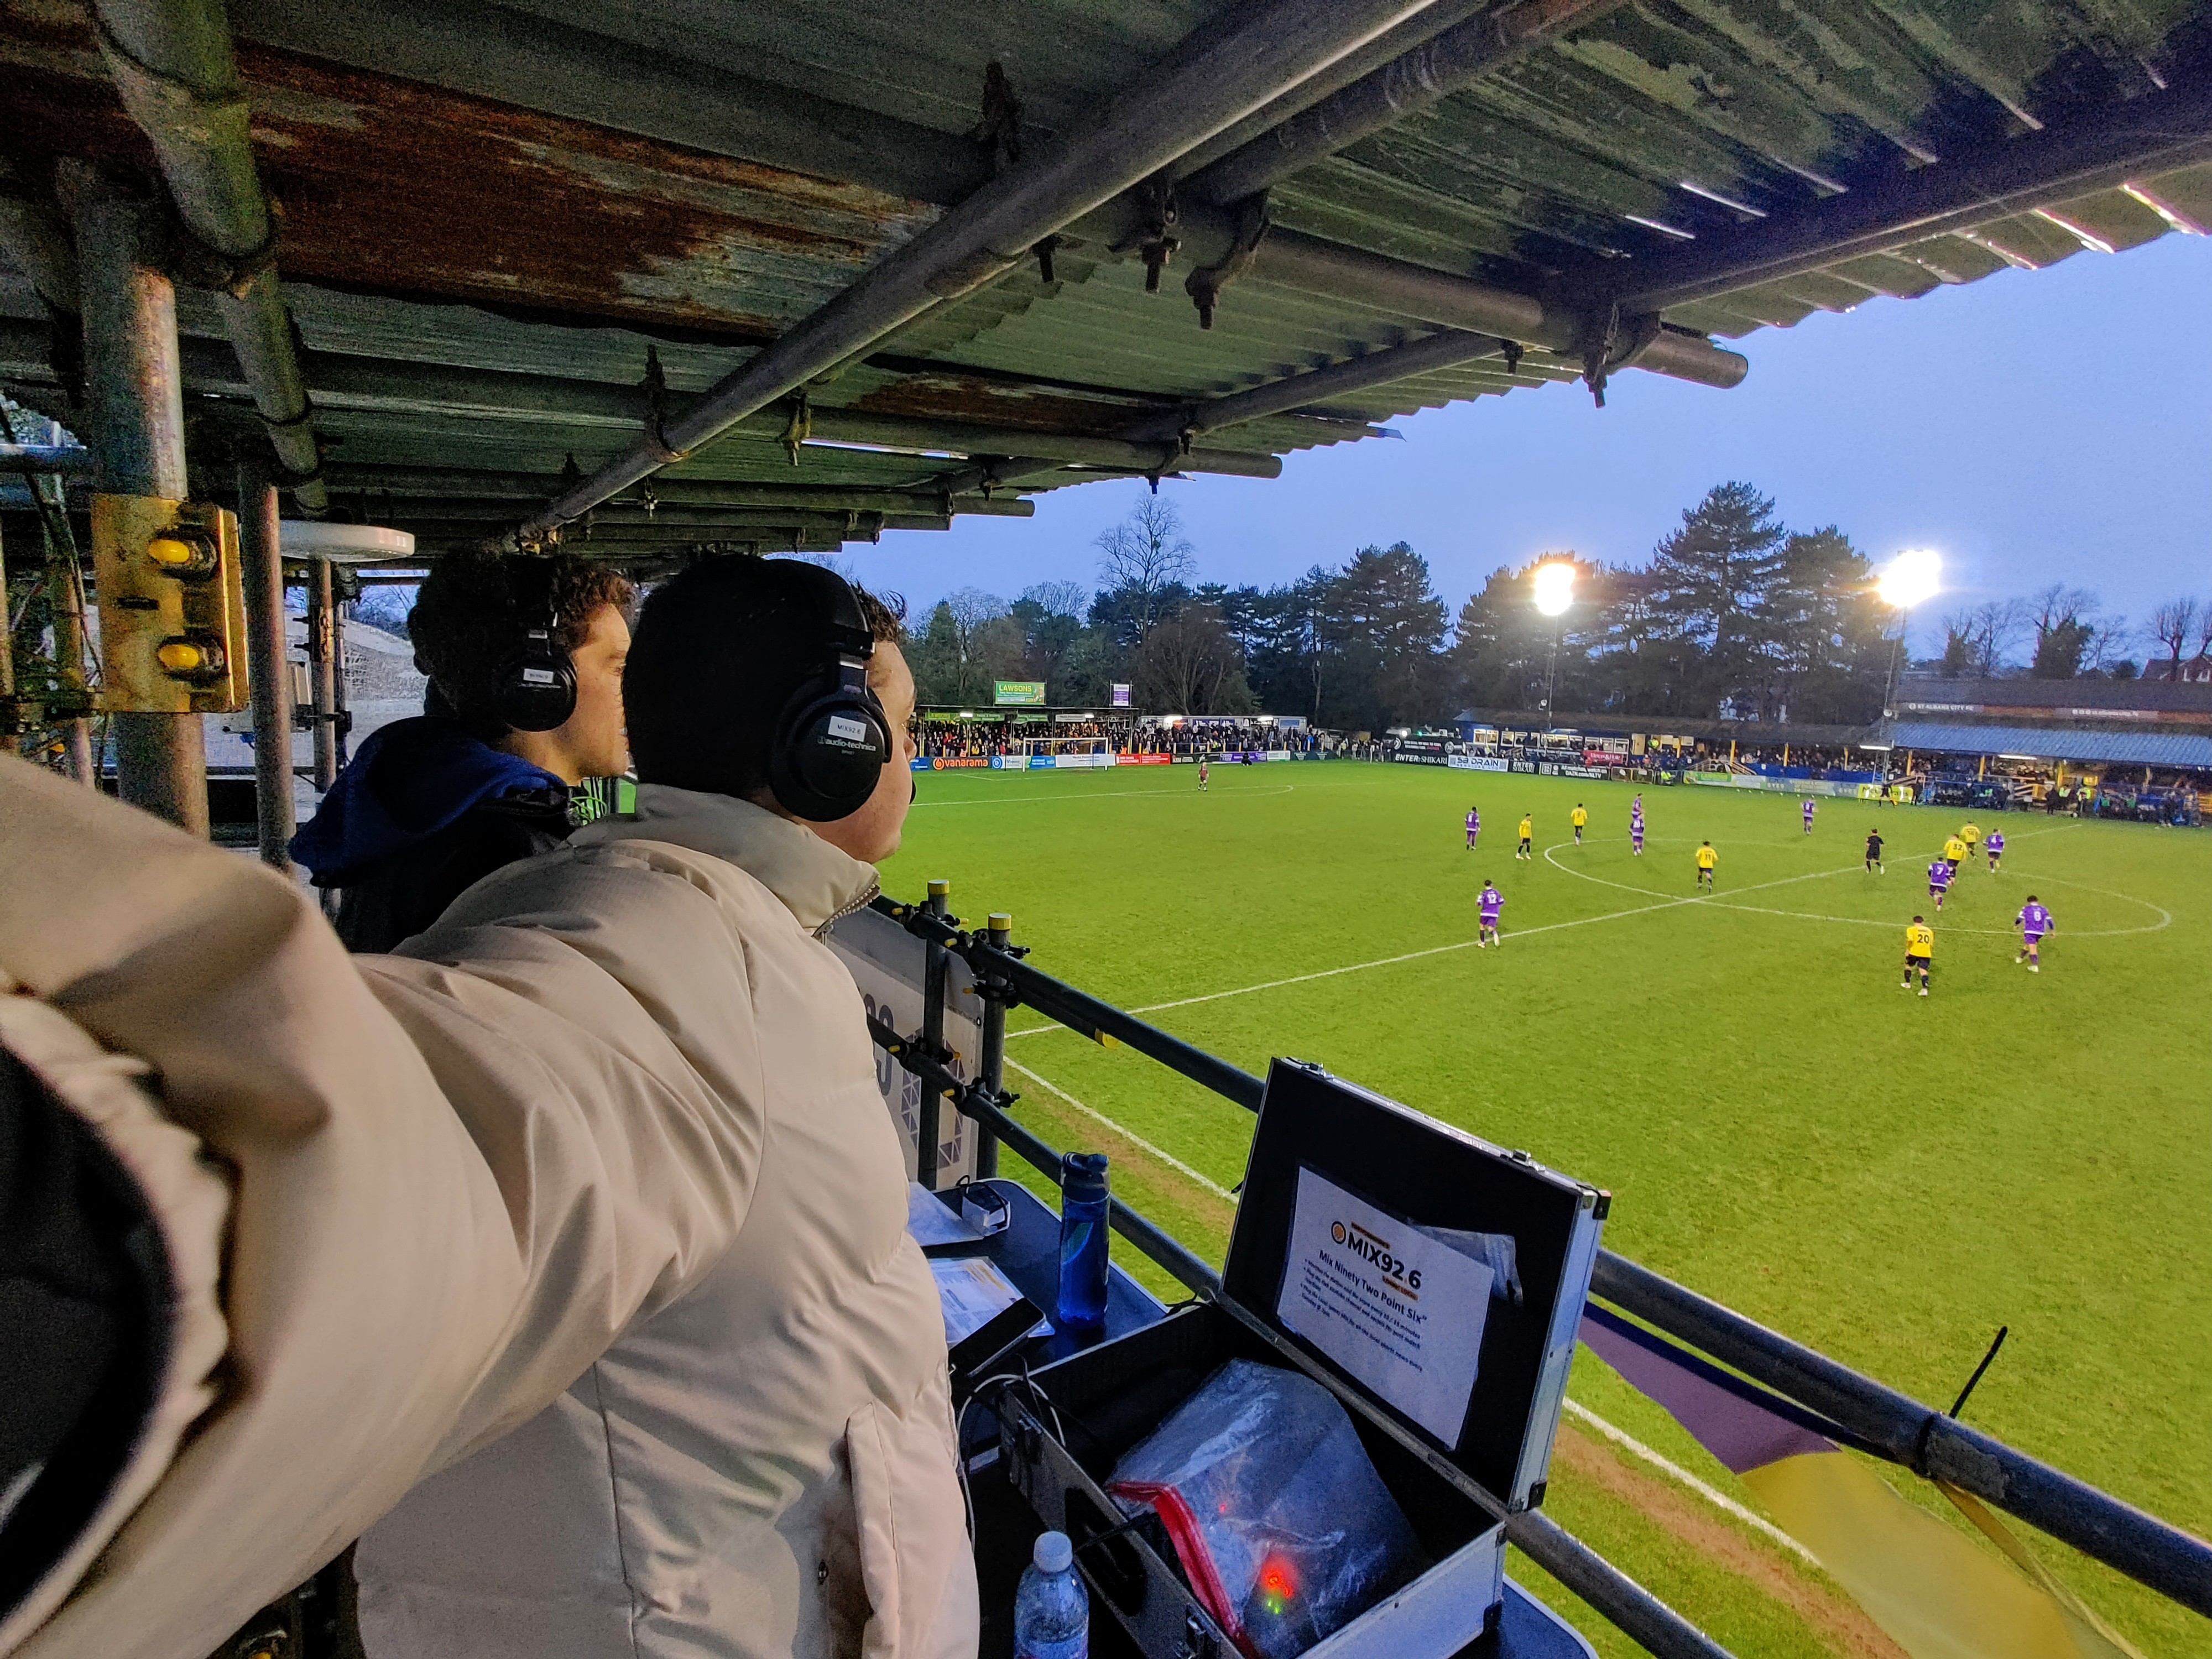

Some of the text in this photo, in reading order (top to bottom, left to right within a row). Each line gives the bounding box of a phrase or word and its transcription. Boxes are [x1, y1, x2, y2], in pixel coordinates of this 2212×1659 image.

[945, 759, 988, 768] vanarama
[1470, 758, 1499, 767] DRAIN
[1937, 866, 1944, 875] 7
[2034, 911, 2042, 921] 8
[1917, 934, 1929, 944] 20
[1347, 1232, 1422, 1290] MIX92.6
[1319, 1250, 1334, 1267] Mix
[1334, 1260, 1360, 1286] Ninety
[1361, 1279, 1379, 1298] Two
[1381, 1292, 1405, 1316] Point
